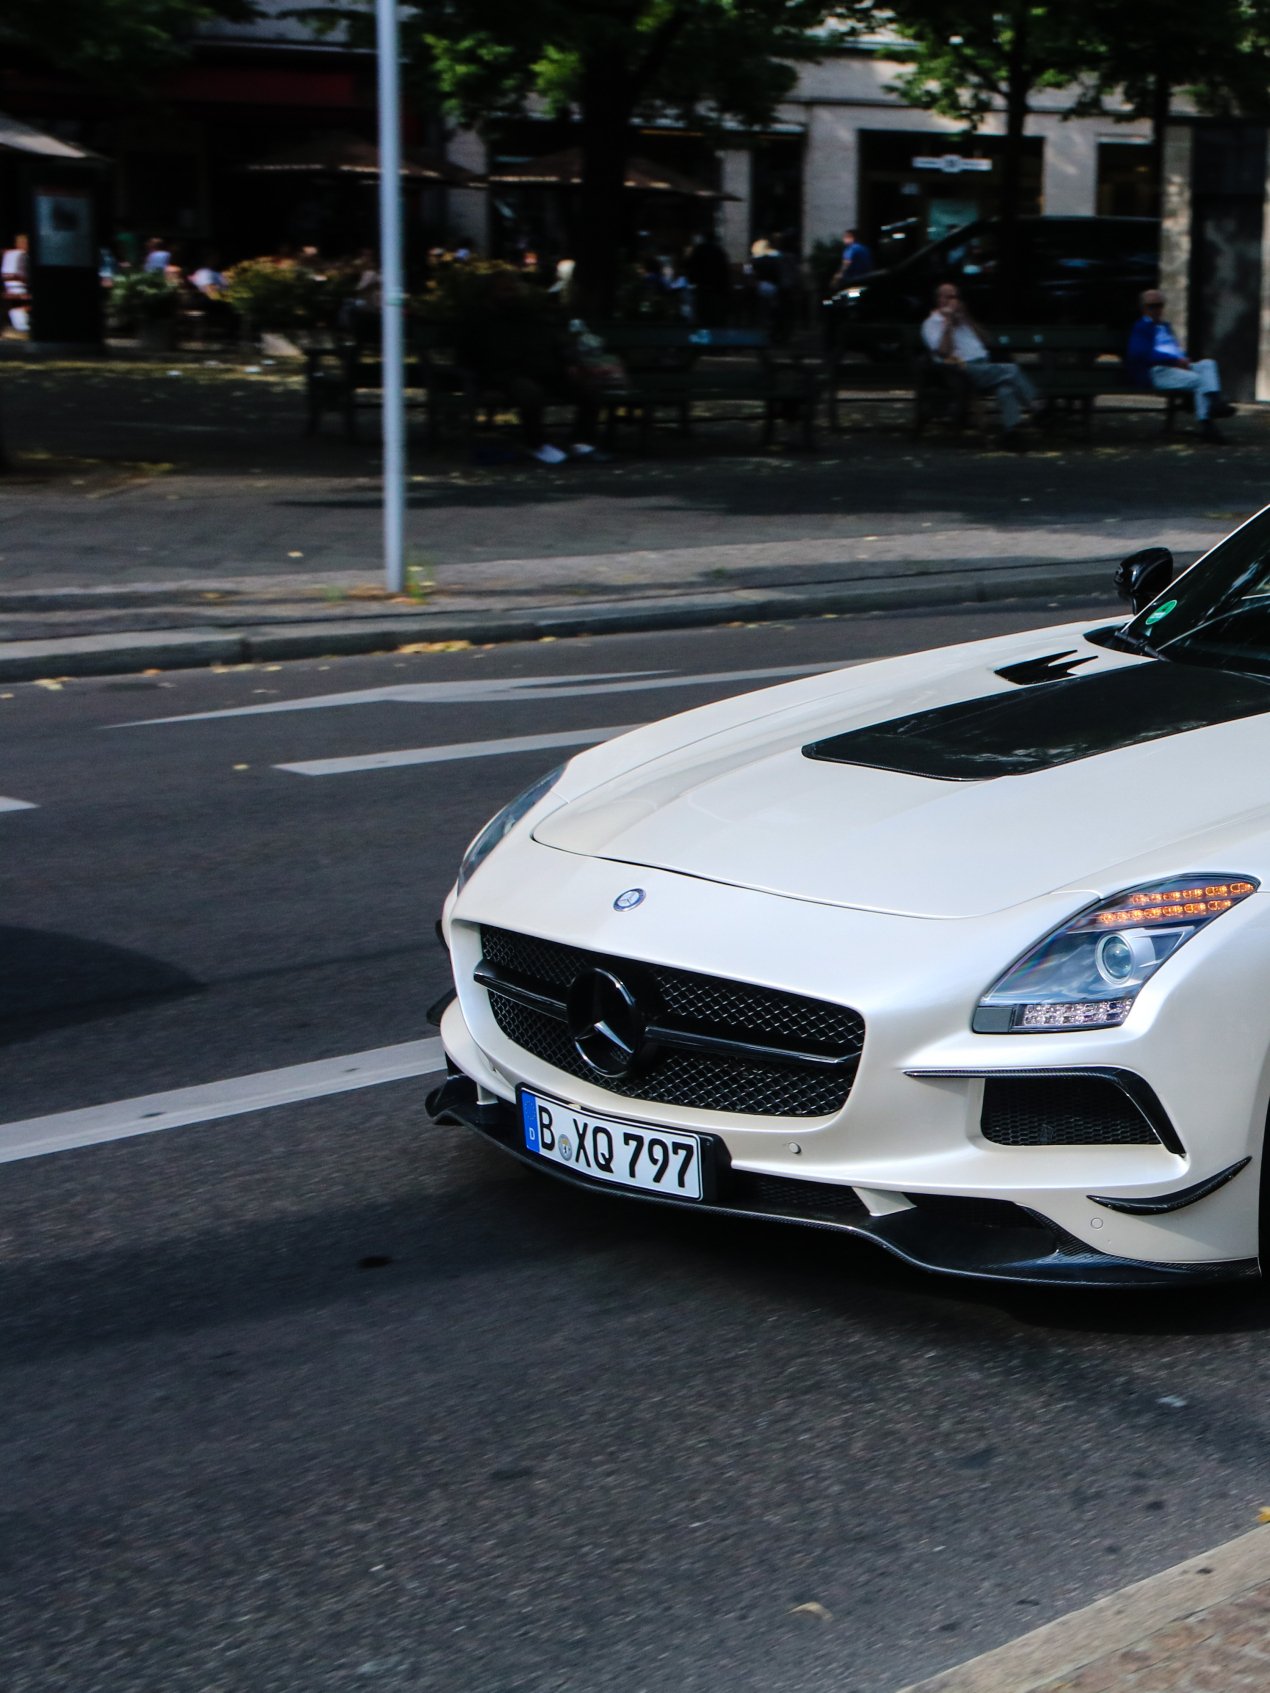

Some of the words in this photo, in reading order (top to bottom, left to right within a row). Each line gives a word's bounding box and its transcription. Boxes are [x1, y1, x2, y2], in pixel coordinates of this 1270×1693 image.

[529, 1127, 536, 1140] D
[538, 1104, 556, 1152] B
[573, 1118, 615, 1174] XQ
[623, 1131, 695, 1188] 797
